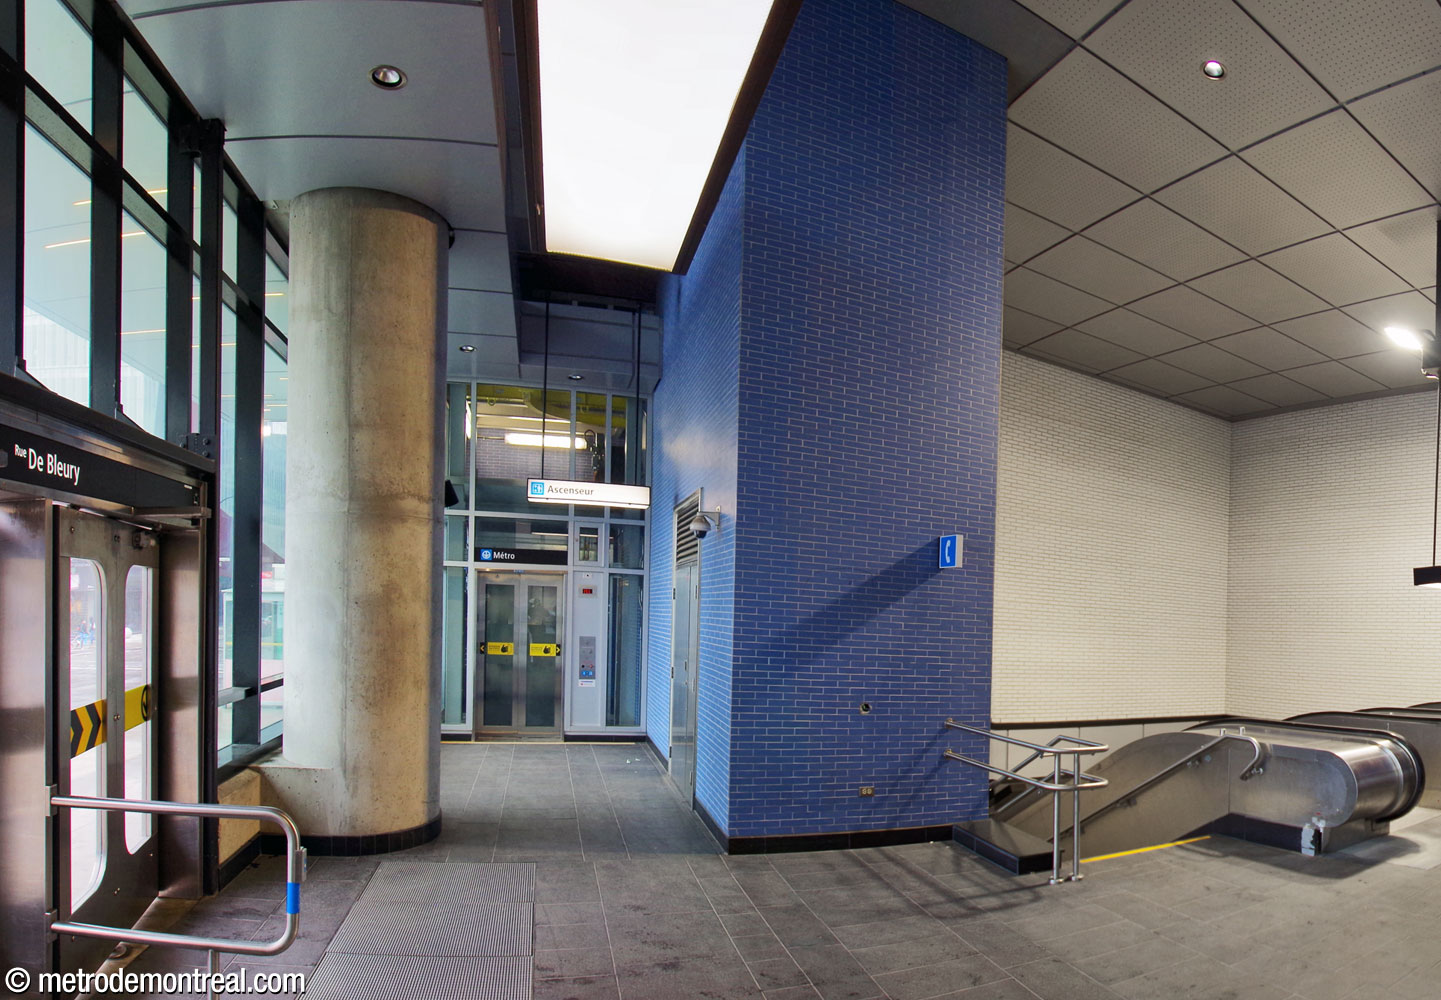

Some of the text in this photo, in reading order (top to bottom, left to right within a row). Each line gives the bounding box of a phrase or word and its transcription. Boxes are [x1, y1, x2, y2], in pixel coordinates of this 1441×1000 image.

[14, 443, 80, 486] Rue De Bleury
[547, 485, 595, 496] Ascenseur
[493, 551, 516, 560] Métro
